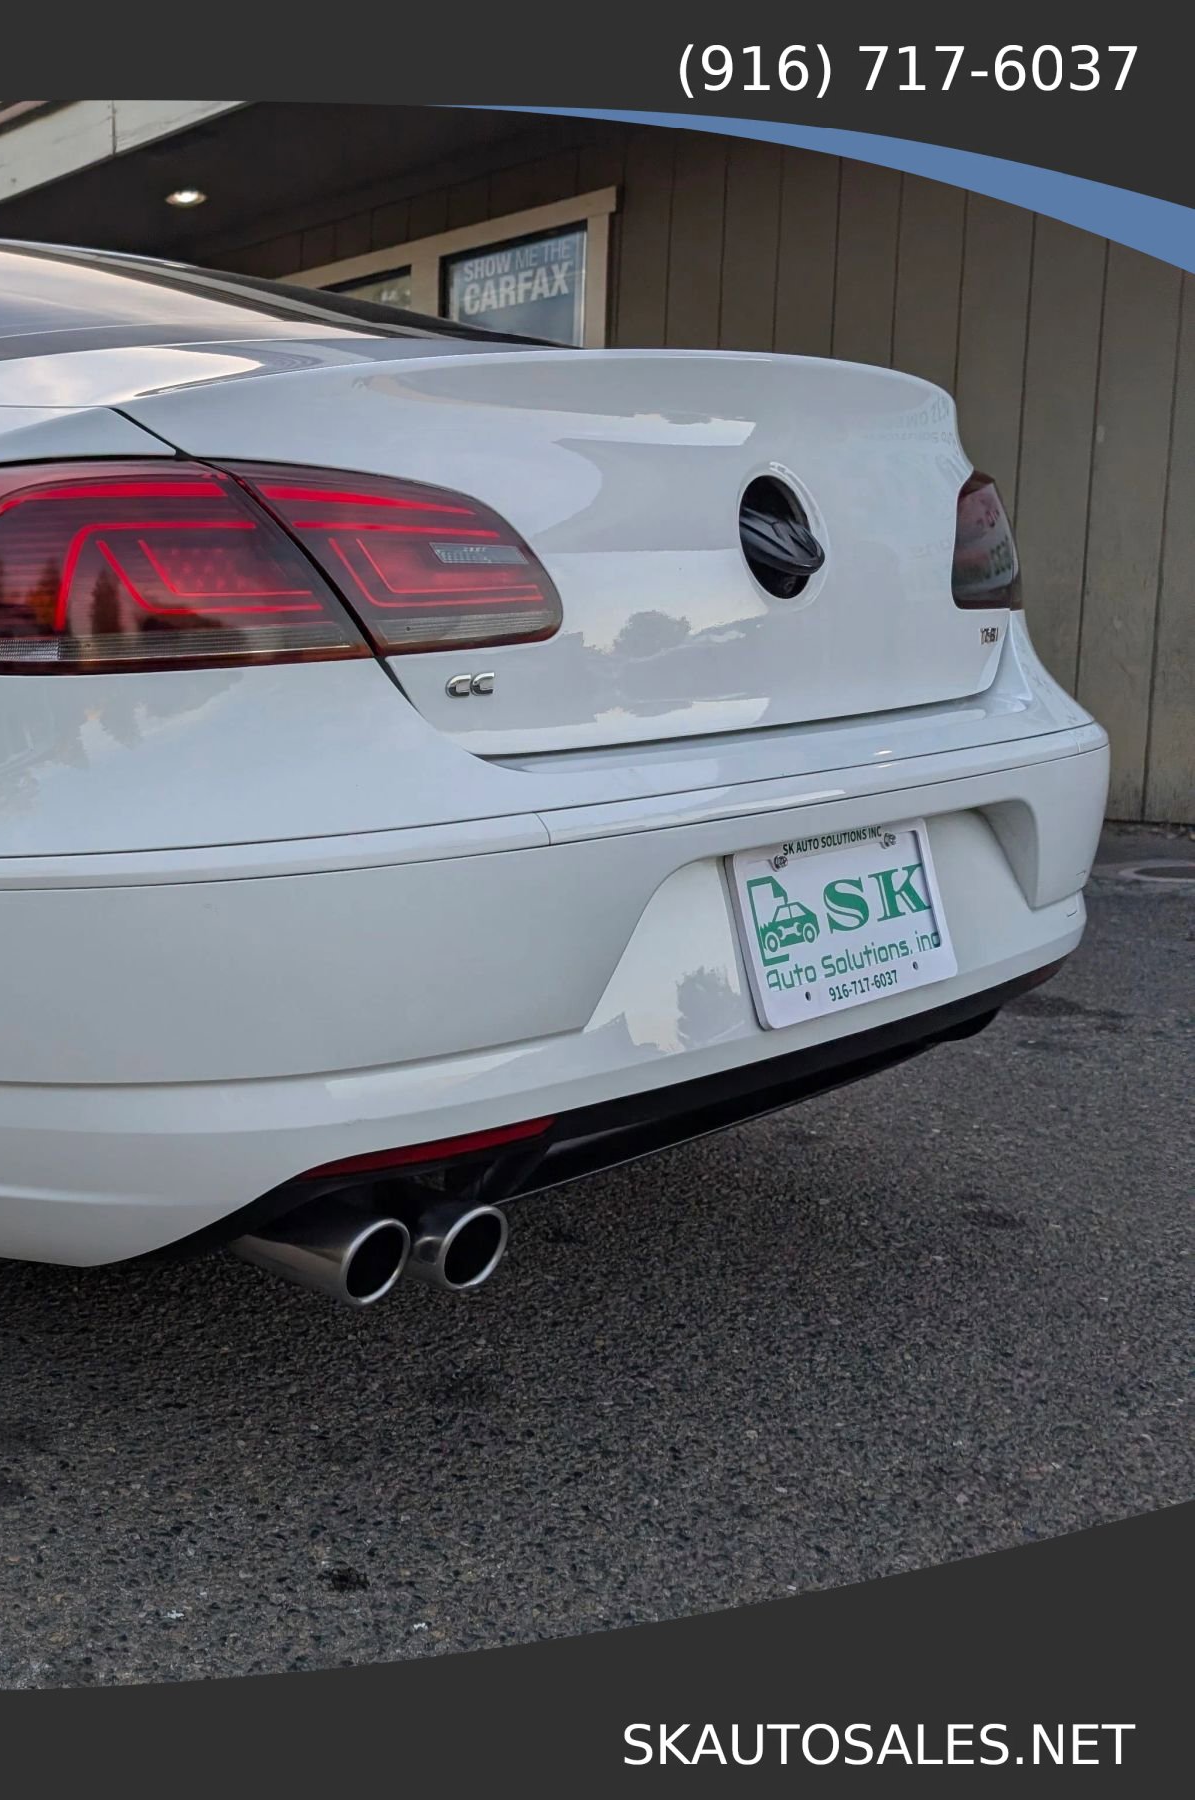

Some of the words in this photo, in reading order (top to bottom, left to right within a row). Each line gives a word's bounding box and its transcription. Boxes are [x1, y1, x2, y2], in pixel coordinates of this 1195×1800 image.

[464, 252, 512, 282] SHOW
[515, 246, 538, 270] ME
[541, 239, 572, 264] THE
[464, 262, 571, 315] CARFAX
[445, 672, 495, 698] CC
[783, 843, 795, 855] SK
[796, 839, 819, 853] AUTO
[821, 829, 867, 848] SOLUTIONS
[868, 826, 882, 838] INC
[823, 863, 932, 934] SK
[766, 963, 817, 991] Auto
[829, 969, 898, 1001] 916-717-6037
